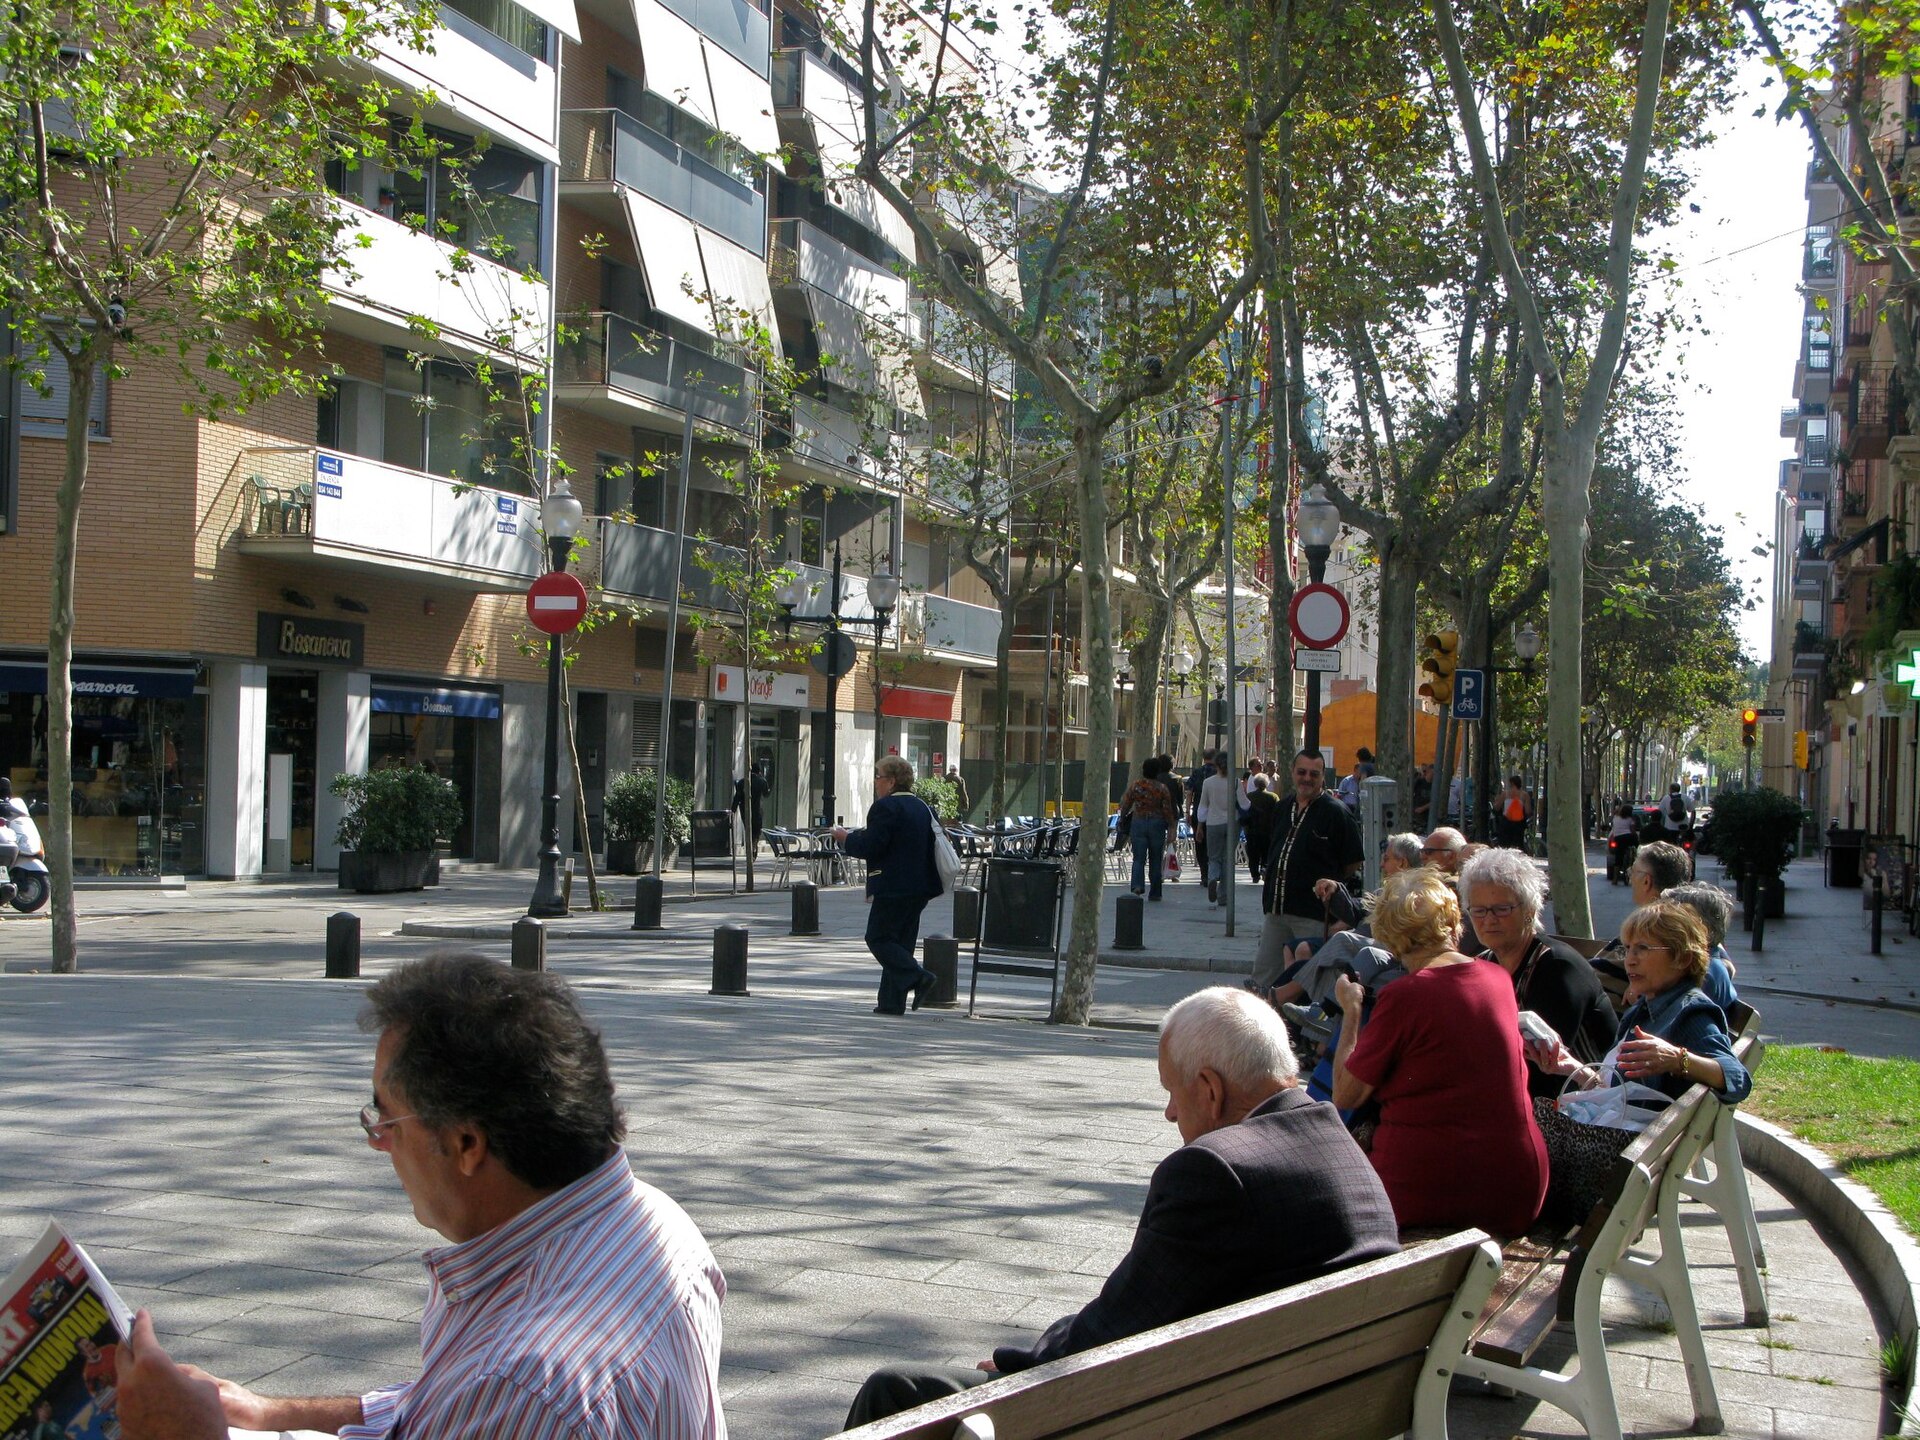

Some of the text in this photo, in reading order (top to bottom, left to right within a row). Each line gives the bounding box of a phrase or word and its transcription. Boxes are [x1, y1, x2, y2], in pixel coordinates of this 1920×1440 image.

[280, 620, 351, 659] Bosanova
[750, 677, 773, 700] Orange
[1461, 676, 1475, 695] P
